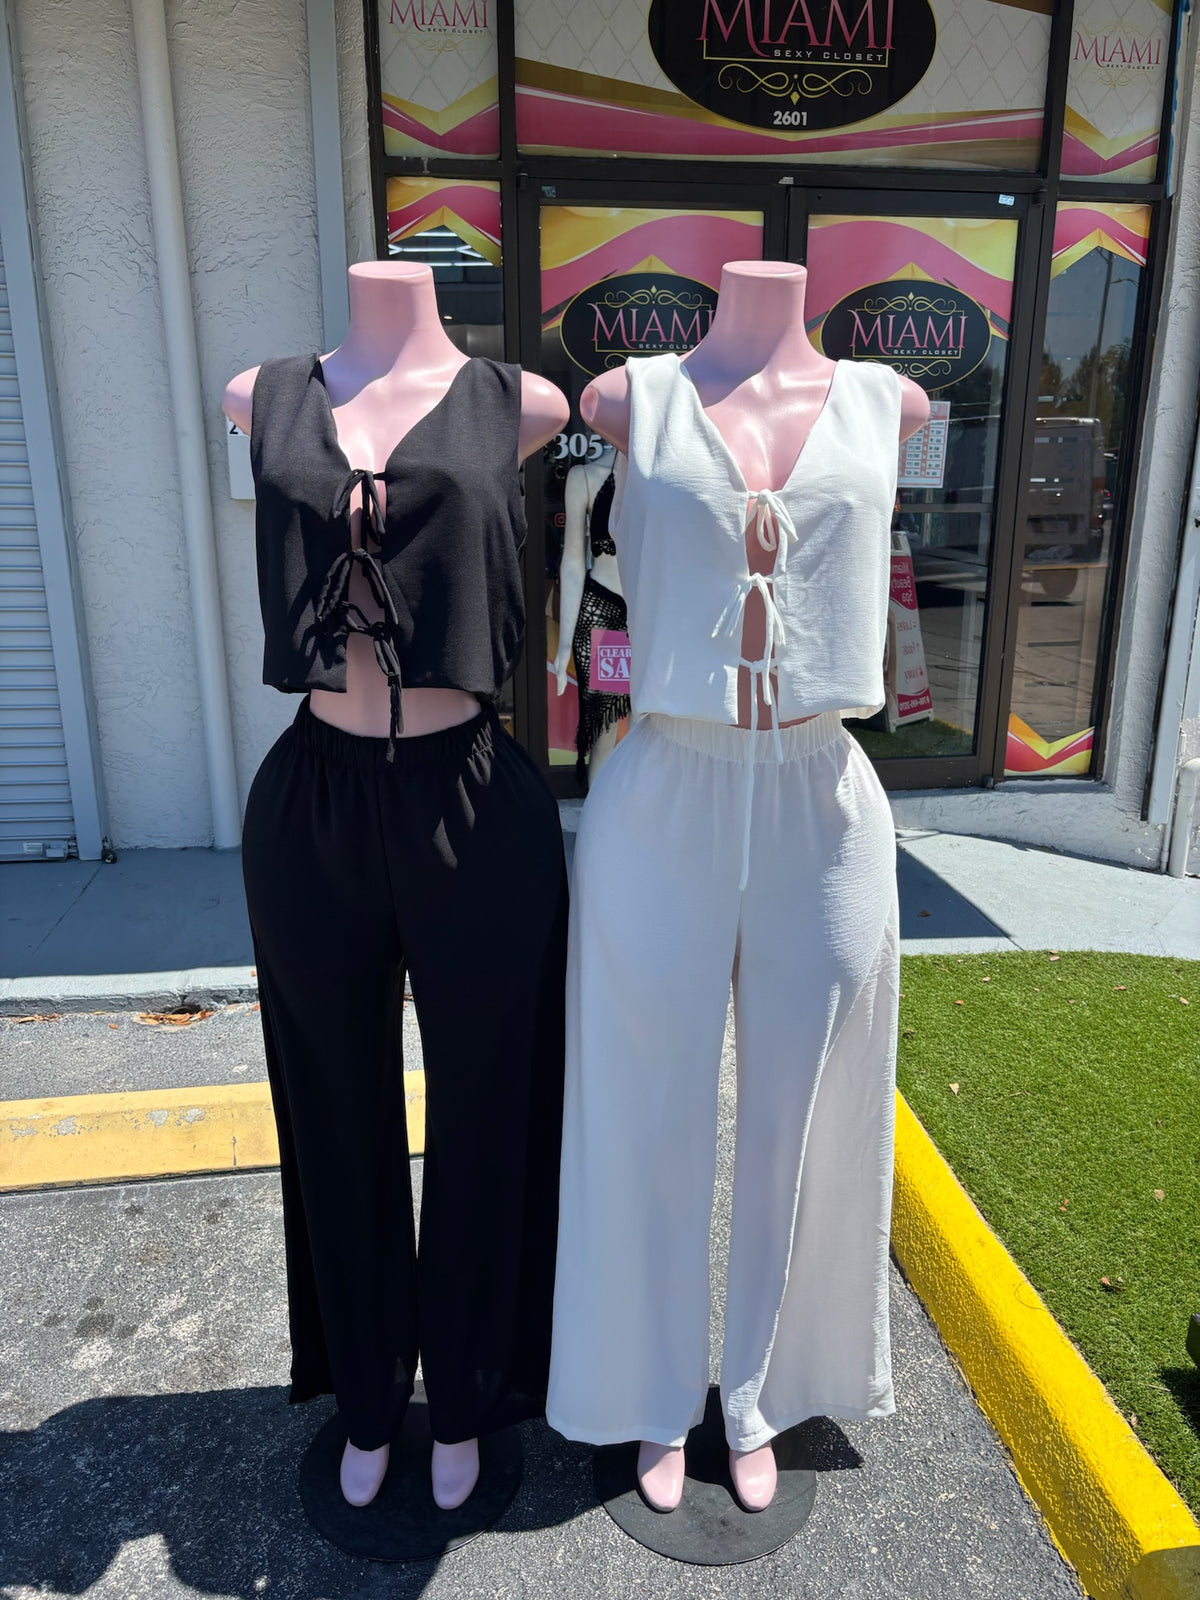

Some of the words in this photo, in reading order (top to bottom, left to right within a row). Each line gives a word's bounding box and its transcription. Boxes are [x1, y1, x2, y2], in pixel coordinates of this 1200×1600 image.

[389, 0, 488, 32] MIAMI
[696, 0, 896, 57] MIAMI
[773, 49, 813, 59] SEXY
[823, 51, 884, 62] CLOSET
[1073, 30, 1163, 68] MIAMI
[773, 110, 808, 126] 2601
[586, 302, 717, 350] MIAMI
[847, 309, 969, 356] MIAMI
